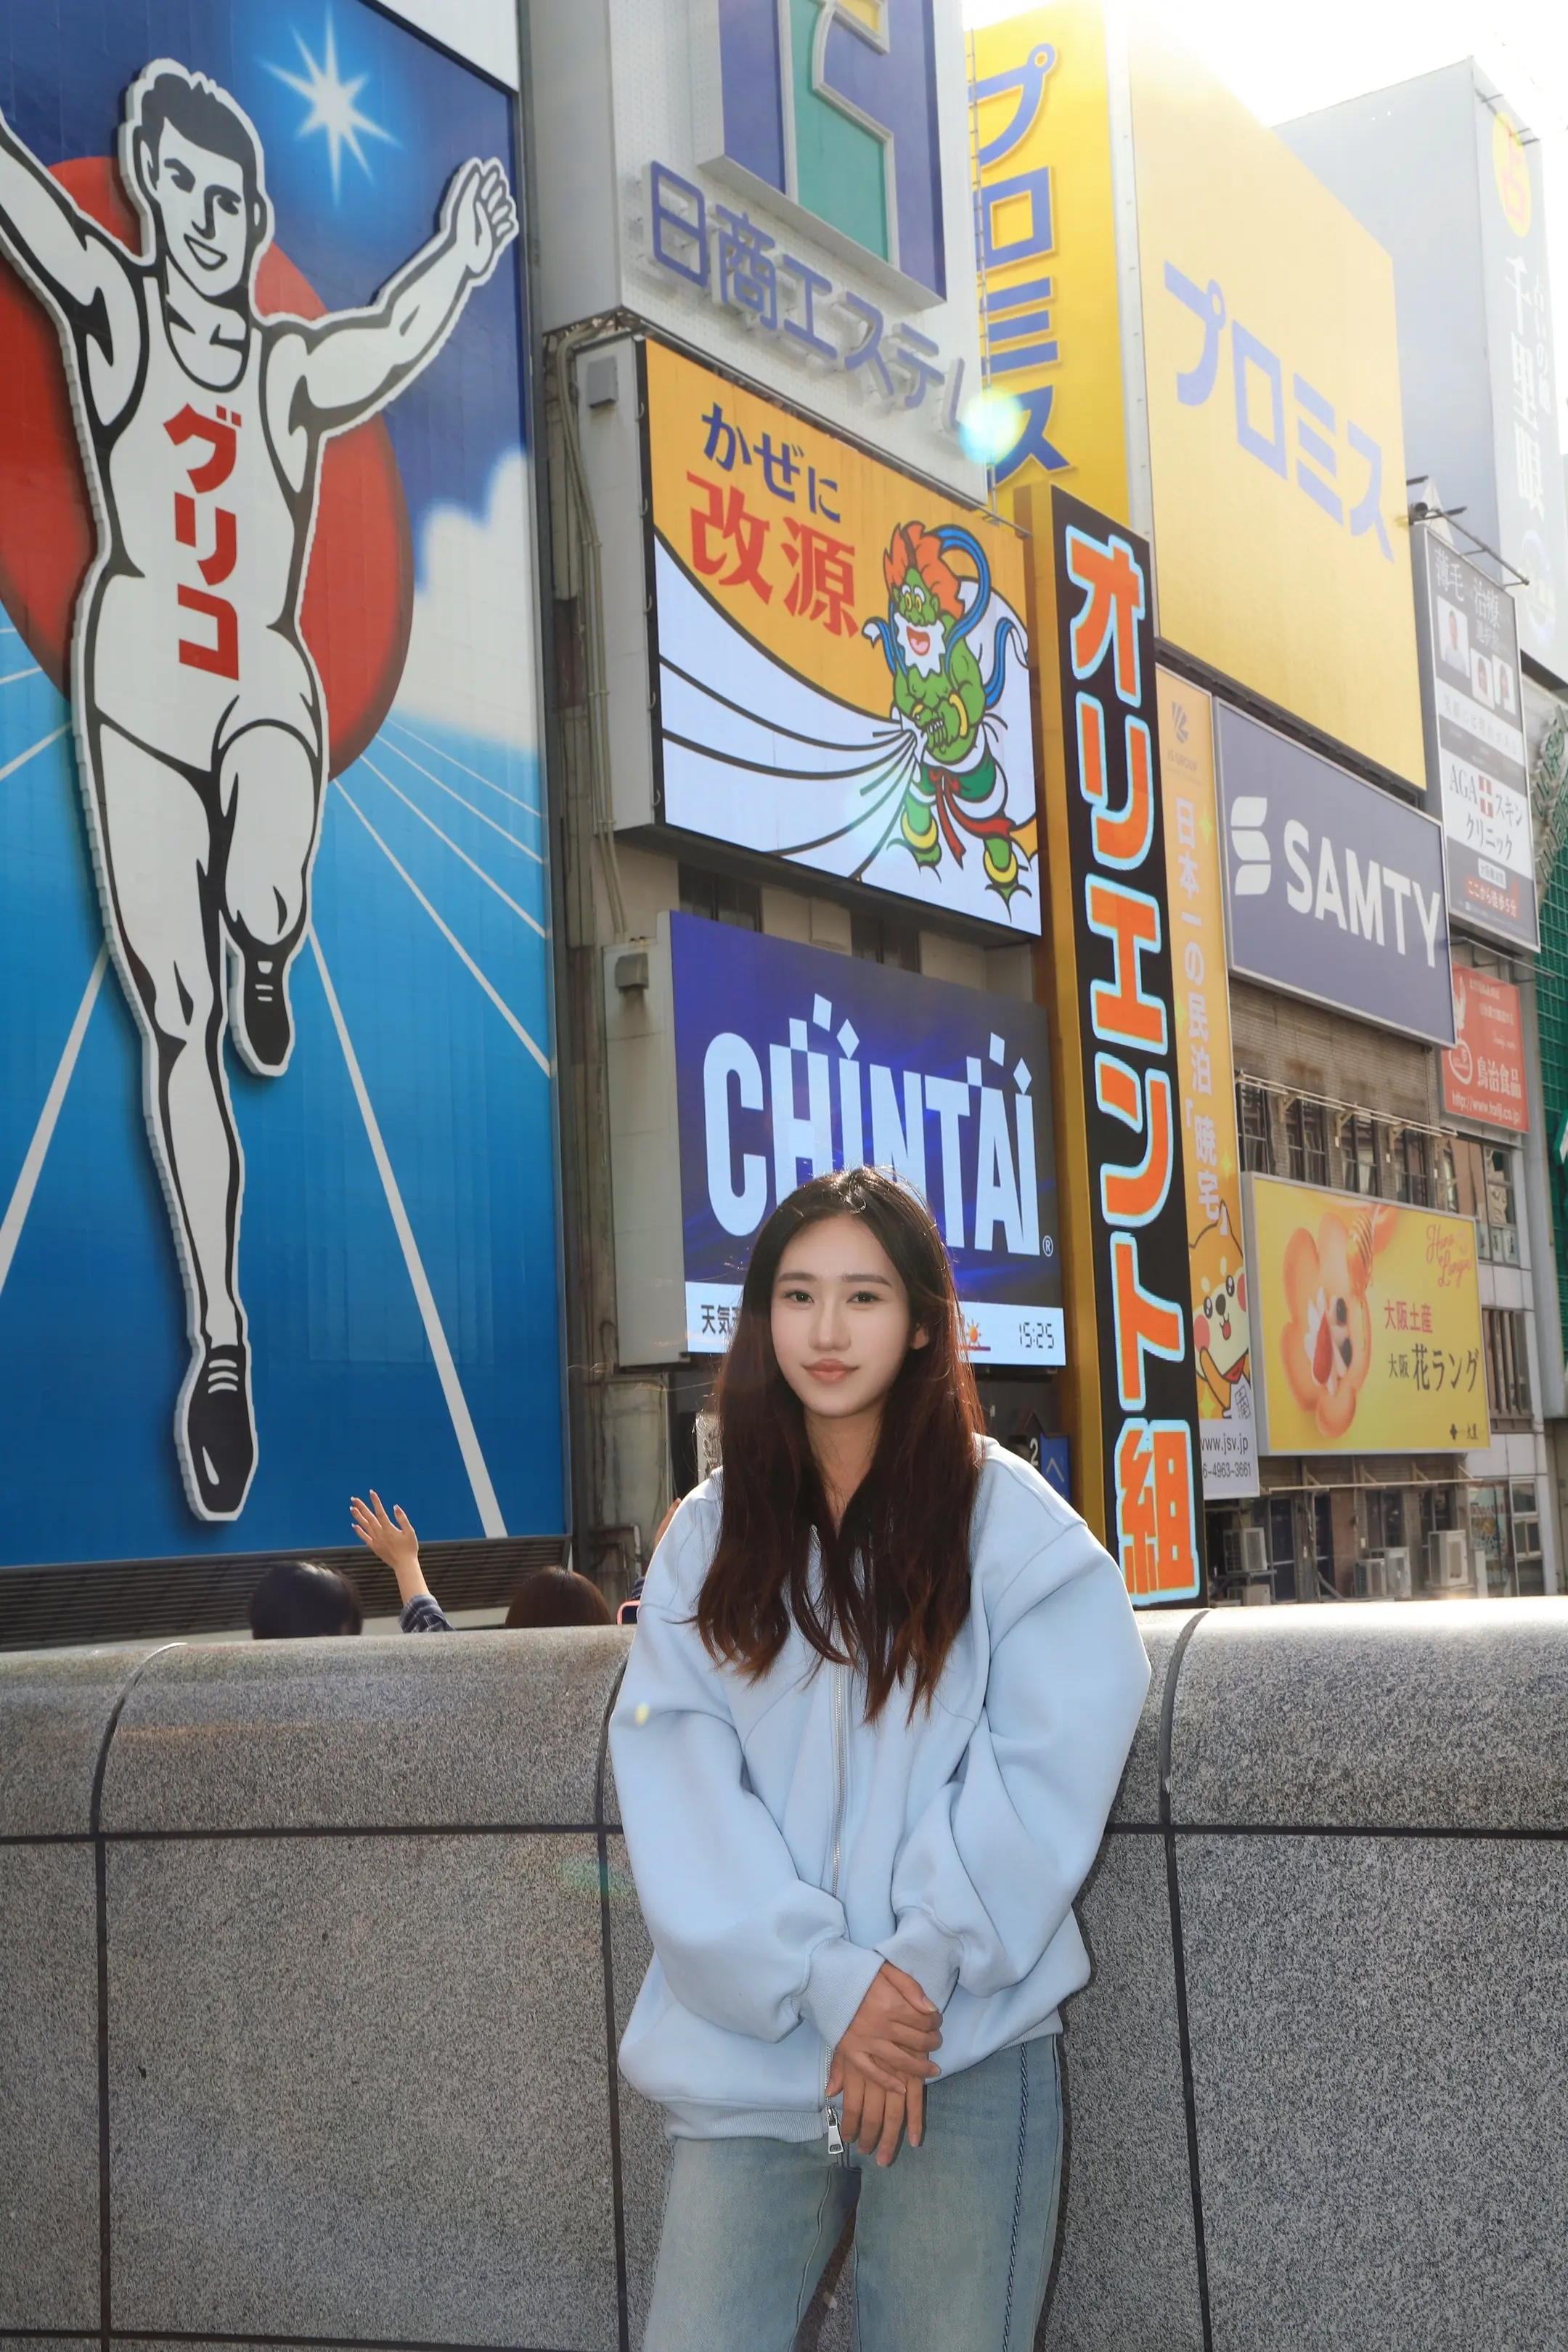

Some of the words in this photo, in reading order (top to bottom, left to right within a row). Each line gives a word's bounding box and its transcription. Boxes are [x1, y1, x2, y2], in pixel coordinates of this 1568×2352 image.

[969, 43, 1071, 491] プロミス
[702, 402, 841, 523] かぜに
[1164, 260, 1395, 564] プロミス
[163, 403, 242, 681] グリコ
[686, 471, 859, 639] 改源
[1449, 764, 1478, 805] AGA
[1466, 812, 1514, 861] クリニック
[1495, 792, 1523, 827] スキン
[1284, 819, 1440, 968] SAMTY
[703, 992, 1041, 1256] CHINTAI
[1019, 1322, 1055, 1349] 15:25
[1384, 1299, 1434, 1334] 大阪土産
[1388, 1352, 1410, 1381] 大阪
[1412, 1343, 1479, 1393] 花ラング
